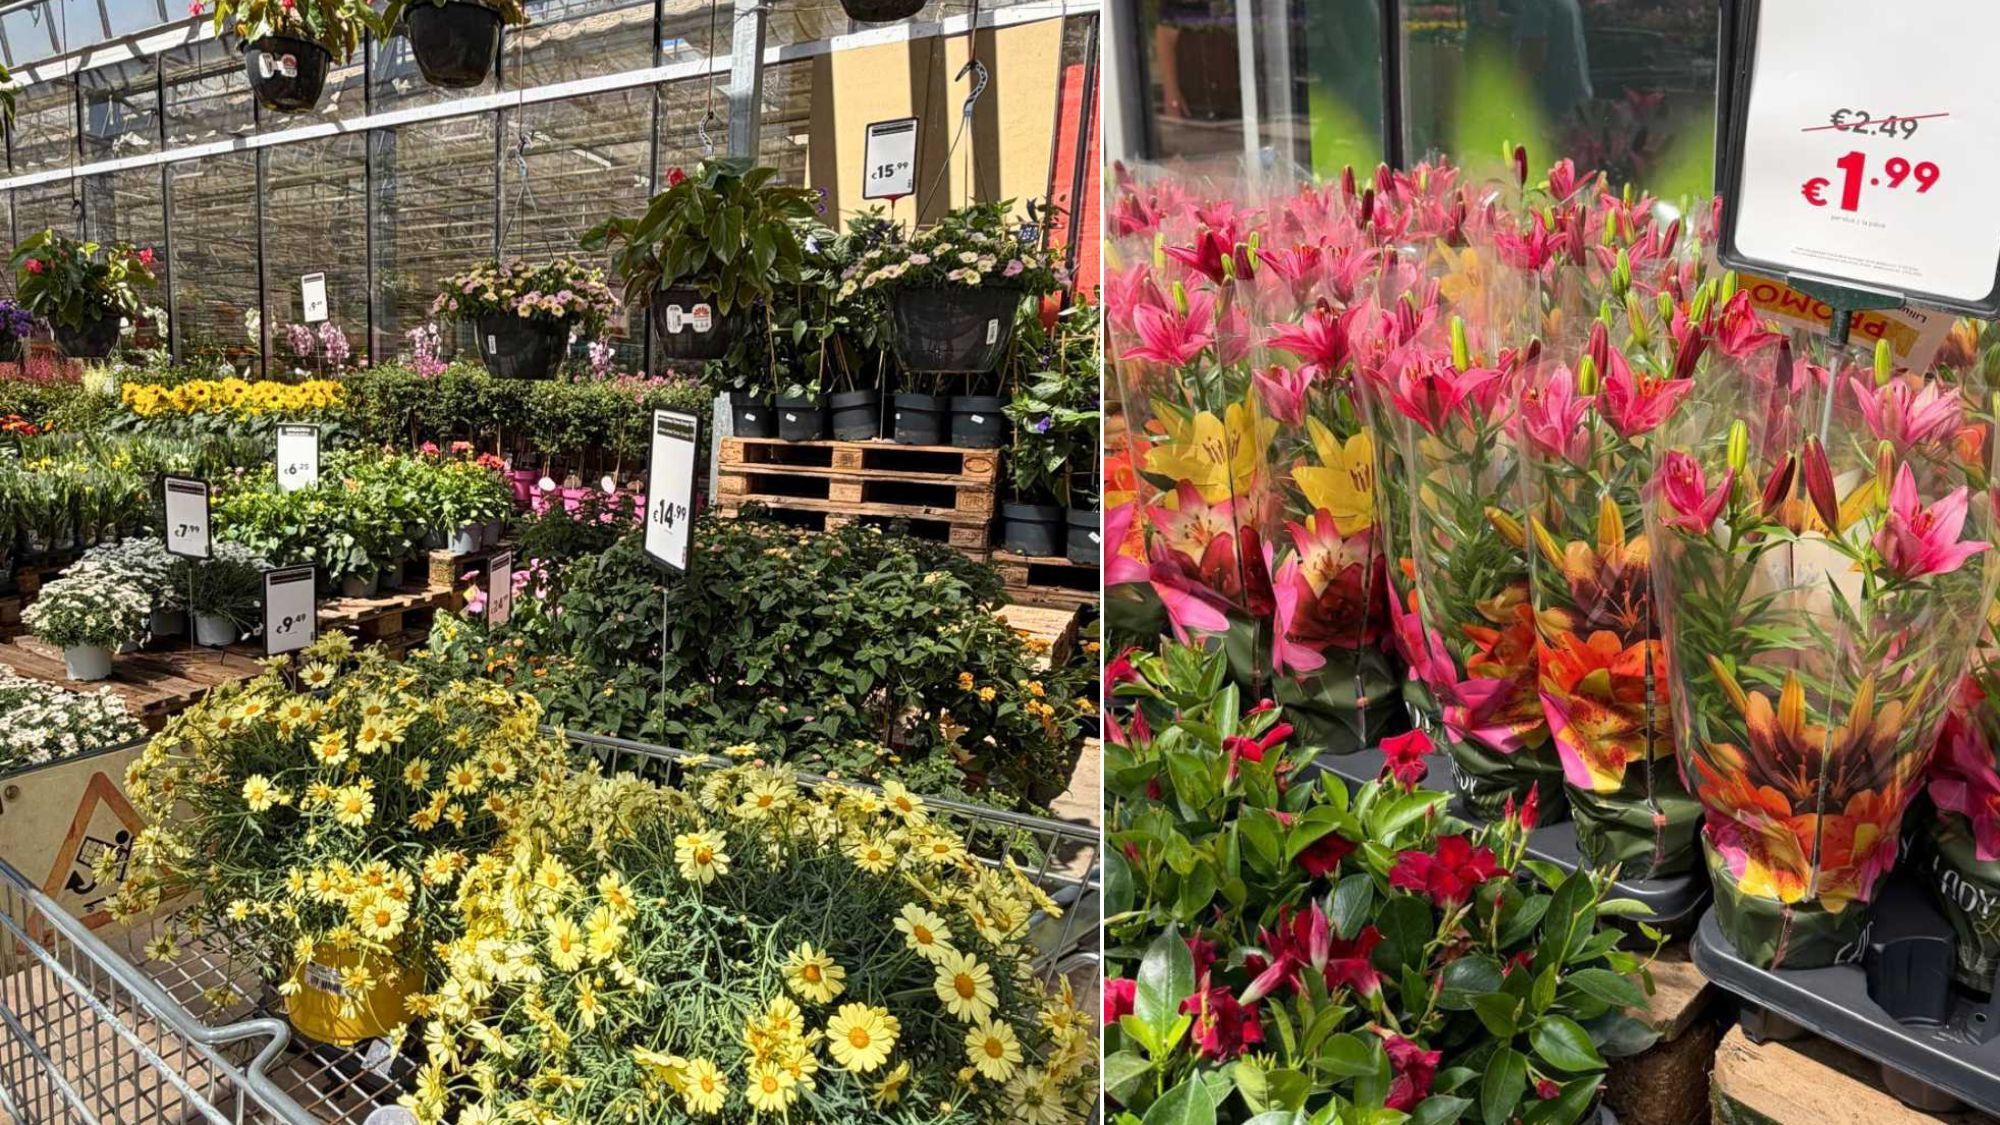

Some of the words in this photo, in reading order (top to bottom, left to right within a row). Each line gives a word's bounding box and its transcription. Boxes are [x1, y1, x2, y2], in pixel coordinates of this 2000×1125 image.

[1830, 108, 1918, 140] €2.49
[1801, 150, 1940, 212] €1.99
[1899, 307, 1928, 324] Liliu
[653, 499, 687, 529] €14.99
